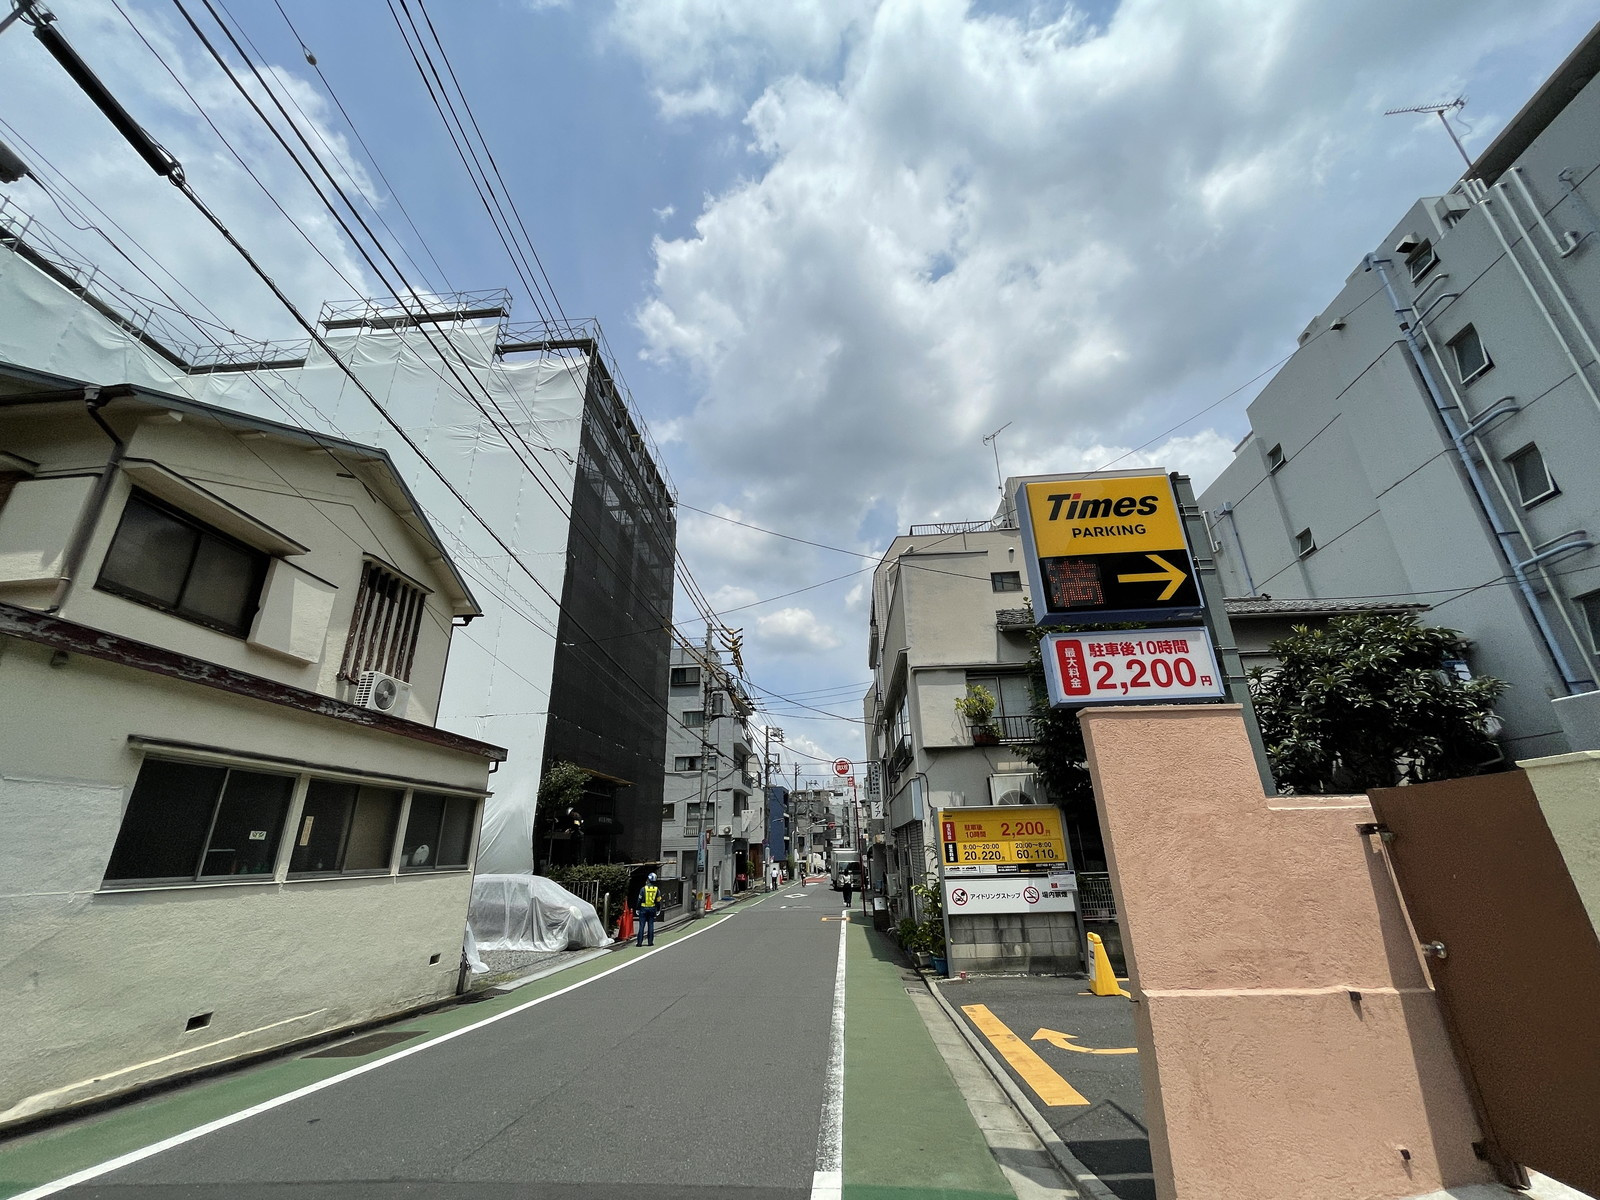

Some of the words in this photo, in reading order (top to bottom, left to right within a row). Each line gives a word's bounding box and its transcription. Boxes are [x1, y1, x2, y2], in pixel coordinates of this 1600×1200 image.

[1046, 492, 1159, 521] Times
[1072, 523, 1147, 539] PARKING
[1047, 559, 1105, 608] 満
[1088, 639, 1190, 658] 駐車後10時間
[1064, 647, 1082, 689] 最大料金
[970, 892, 1021, 900] アイドリングストップ
